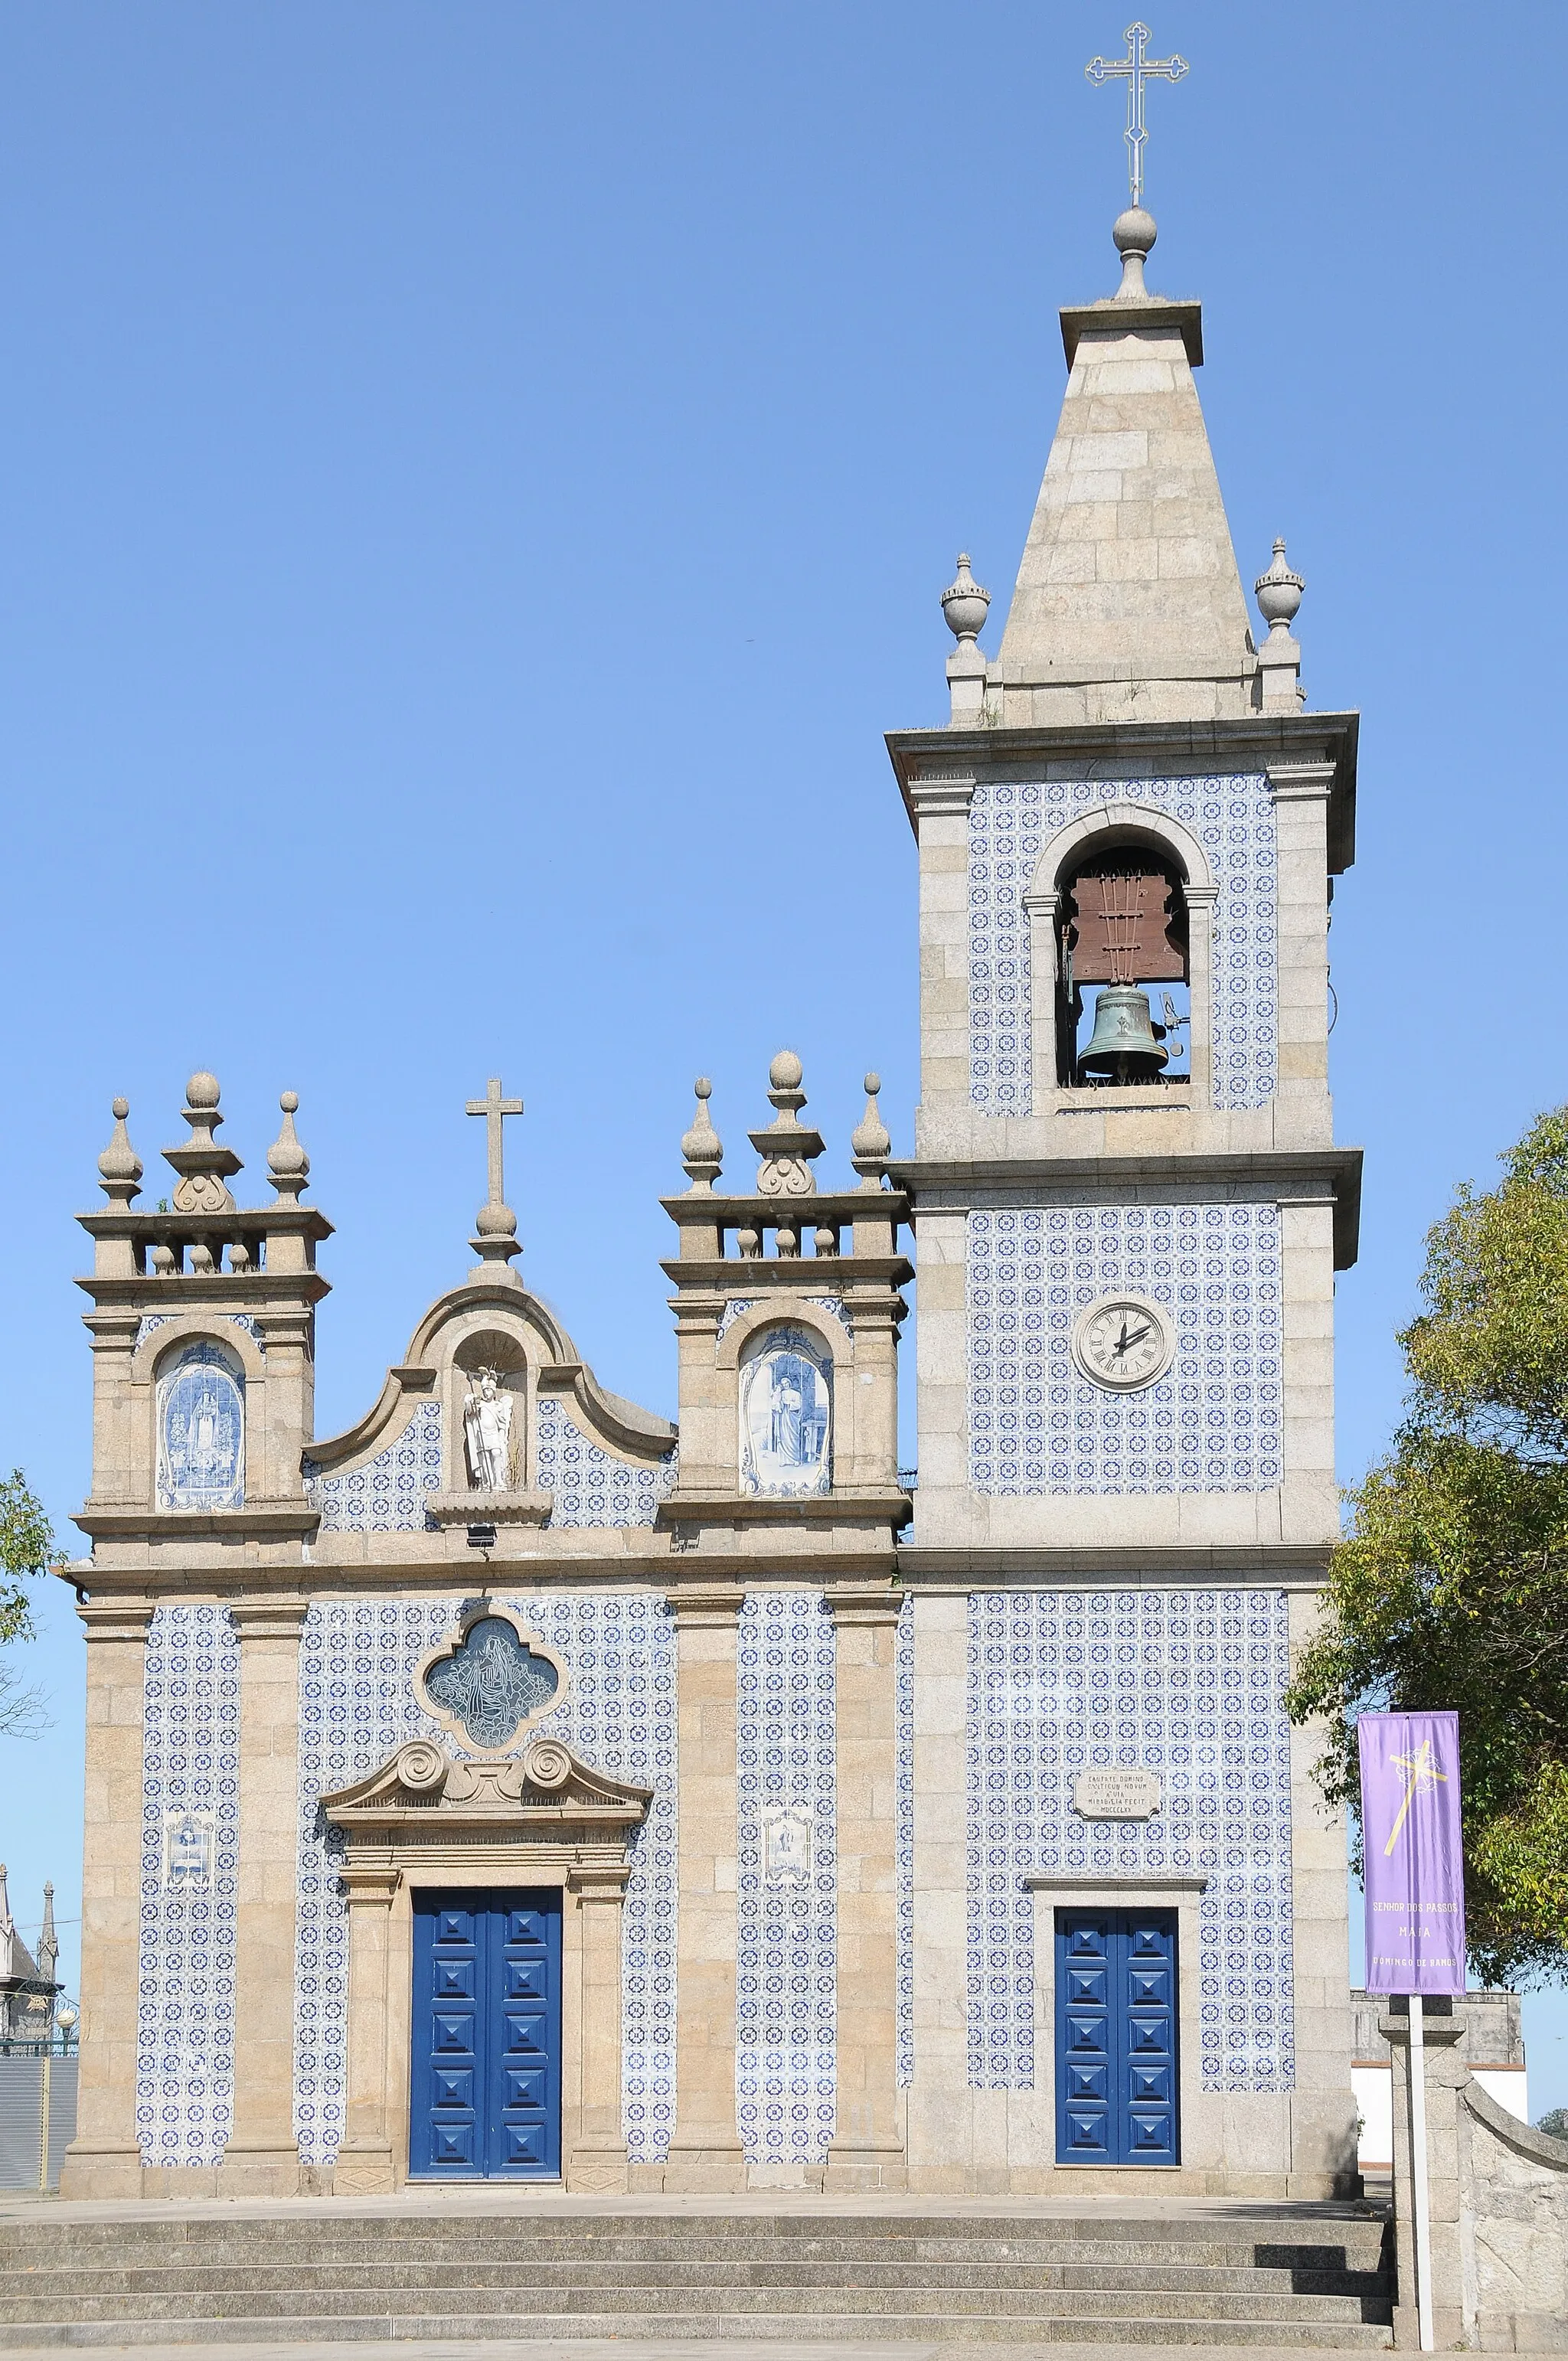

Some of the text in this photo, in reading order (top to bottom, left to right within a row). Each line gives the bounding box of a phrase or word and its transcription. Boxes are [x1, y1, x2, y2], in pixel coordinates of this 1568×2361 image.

[1105, 1314, 1114, 1326] XI
[1119, 1311, 1127, 1321] XII
[1133, 1314, 1140, 1324] I
[1090, 1325, 1105, 1334] X
[1120, 1363, 1128, 1373] VI
[1373, 1902, 1458, 1912] SENHOR DOS PASSOS
[1399, 1926, 1430, 1938] MAIA
[1373, 1957, 1456, 1967] DOMINGO DE RAMOS
